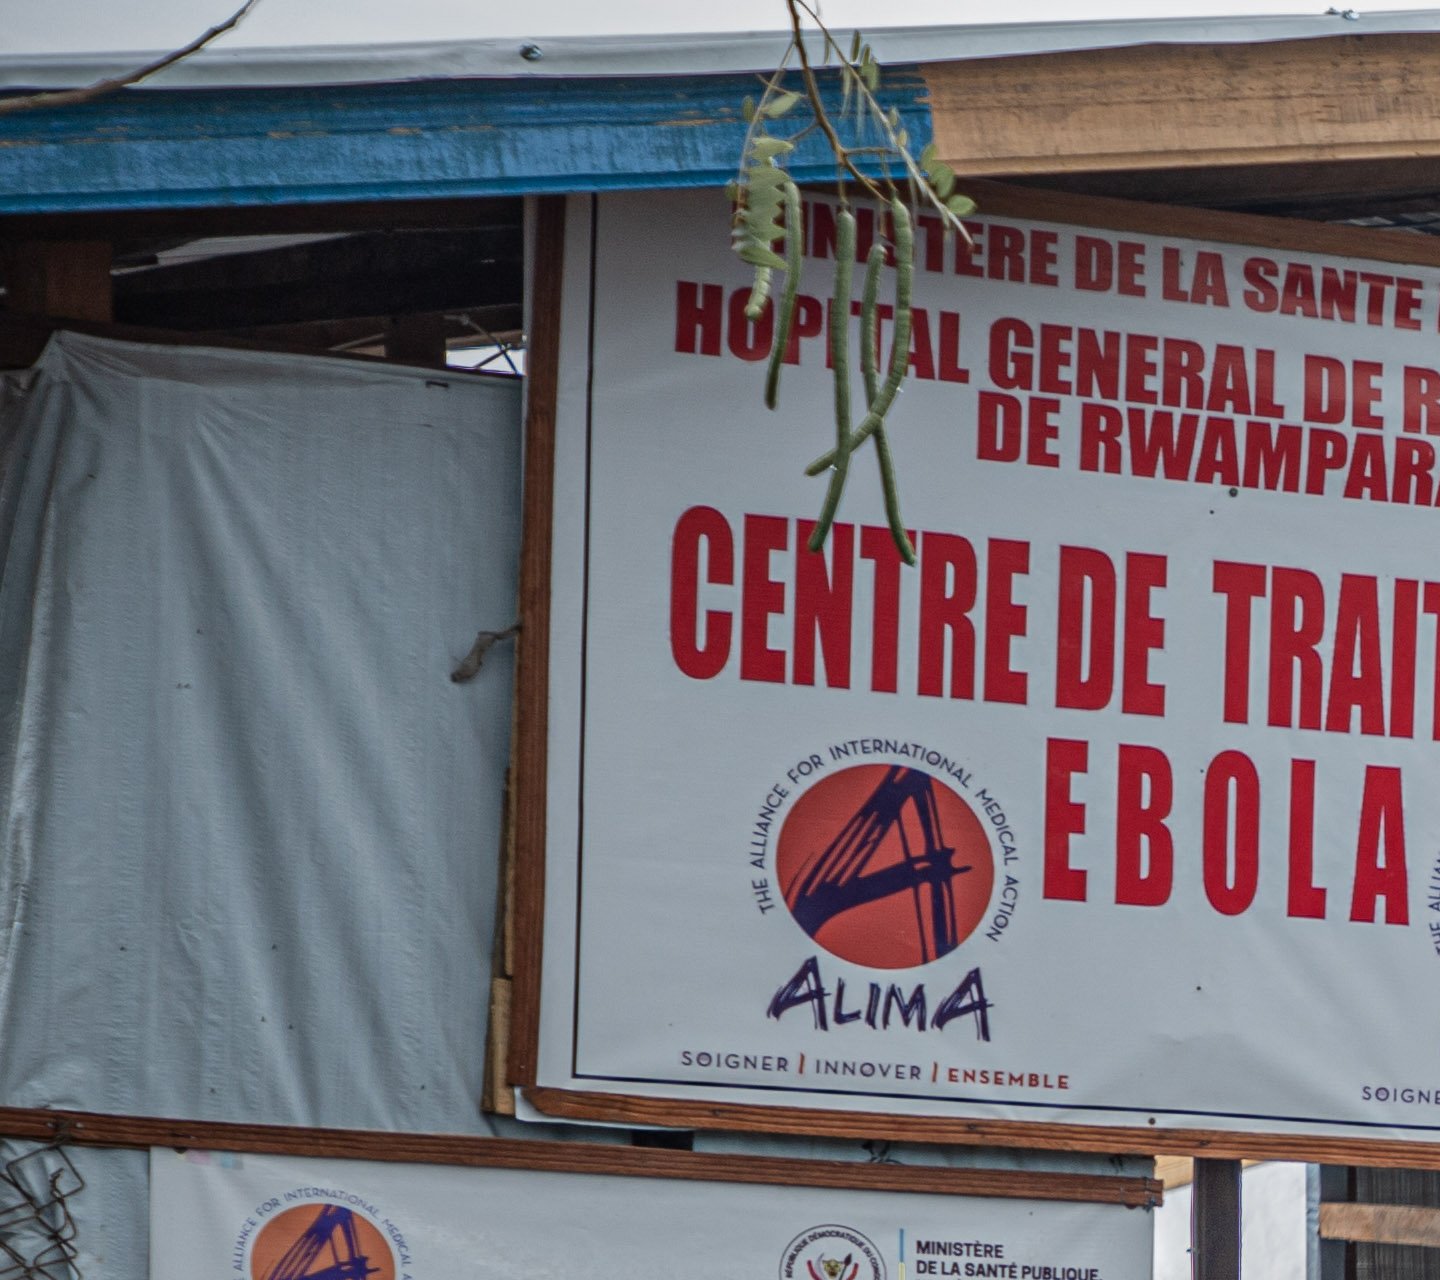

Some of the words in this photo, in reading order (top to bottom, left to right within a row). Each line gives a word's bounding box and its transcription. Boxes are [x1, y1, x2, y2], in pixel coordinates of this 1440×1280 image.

[1075, 234, 1145, 297] DE
[1162, 246, 1229, 308] LA
[1243, 256, 1422, 333] SANTE
[674, 279, 970, 385] HOPTAL
[988, 317, 1285, 419] GENERAL
[1304, 353, 1384, 430] DE
[976, 390, 1060, 469] DE
[669, 504, 1032, 705] CENTRE
[1055, 544, 1168, 718] DE
[786, 754, 825, 786] FOR
[828, 738, 972, 789] INTERNATIONAL
[750, 783, 788, 869] ALLIANCE
[974, 787, 1019, 867] MEDICAL
[1042, 737, 1410, 926] EBOLA
[752, 875, 773, 916] THE
[984, 873, 1018, 943] ACTION
[766, 955, 995, 1043] ALIMA
[681, 1050, 789, 1074] SOIGNER
[814, 1057, 922, 1083] INNOVER
[947, 1067, 1071, 1090] ENSEMBLE
[916, 1240, 1005, 1259] MINISTÈRE
[916, 1261, 937, 1275] DE
[941, 1262, 962, 1276] LA
[965, 1261, 1018, 1279] SANTÉ
